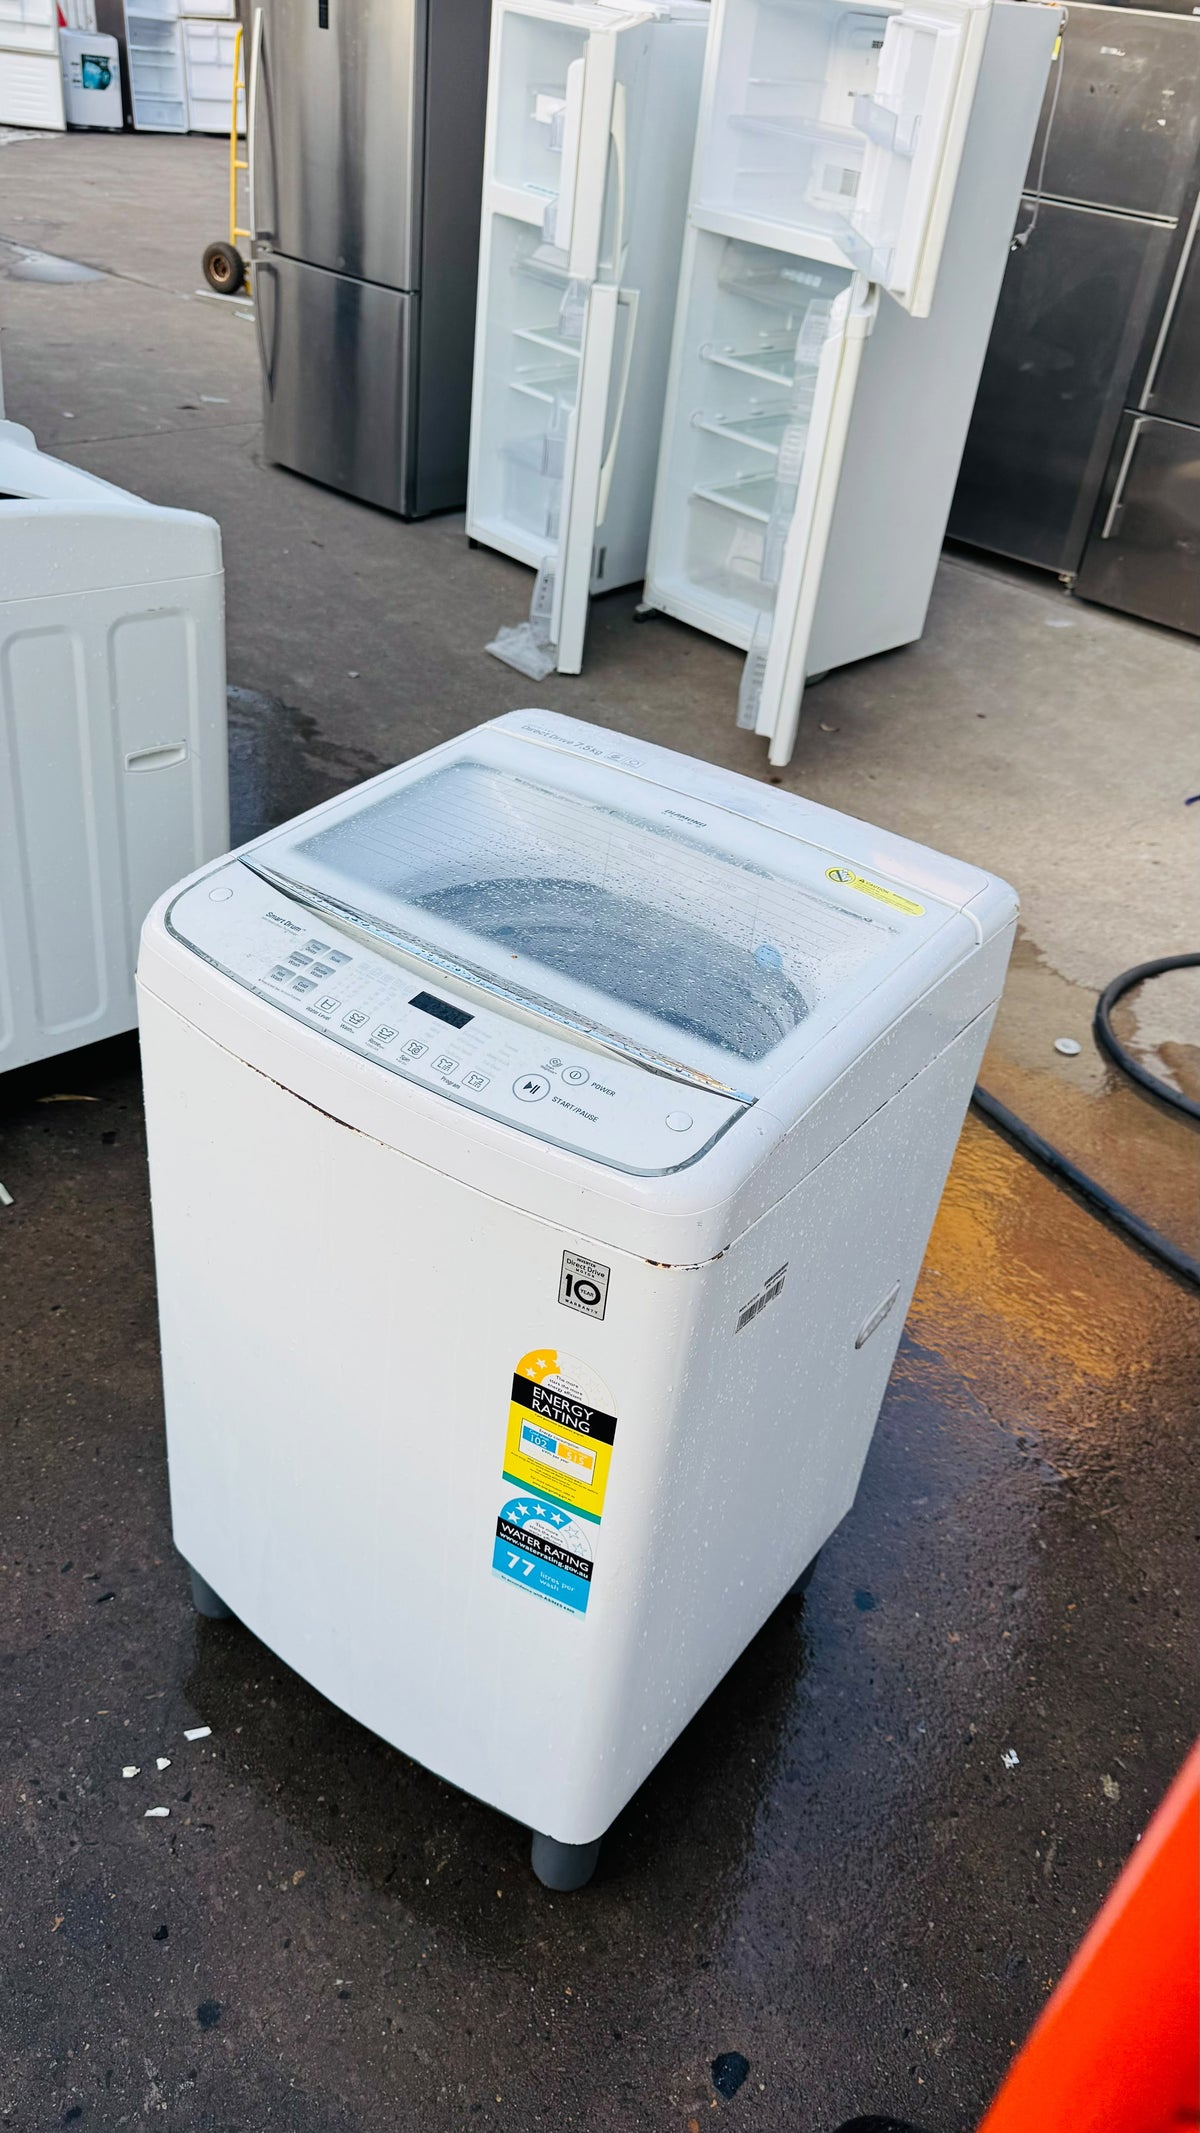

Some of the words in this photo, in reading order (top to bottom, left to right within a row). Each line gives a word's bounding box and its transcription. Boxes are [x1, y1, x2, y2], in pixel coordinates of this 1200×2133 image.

[521, 725, 550, 737] Direct
[549, 734, 574, 745] Drive
[265, 911, 285, 924] Smart
[283, 920, 302, 932] Drum
[305, 1005, 319, 1016] Water
[318, 1010, 332, 1021] Level
[440, 1075, 461, 1090] Program
[590, 1081, 616, 1098] POWER
[551, 1095, 599, 1123] START/PAUSE
[566, 1257, 587, 1271] Direct
[587, 1265, 606, 1279] Drive
[565, 1273, 602, 1306] 10
[532, 1386, 594, 1421] ENERGY
[531, 1398, 591, 1434] RATING
[530, 1434, 548, 1449] 102
[499, 1531, 589, 1580] www.waterrating.gov.au
[501, 1521, 541, 1550] WATER
[544, 1544, 589, 1572] RATING
[506, 1550, 536, 1577] 77
[539, 1578, 560, 1592] wash
[540, 1571, 561, 1585] litres
[561, 1582, 576, 1592] per
